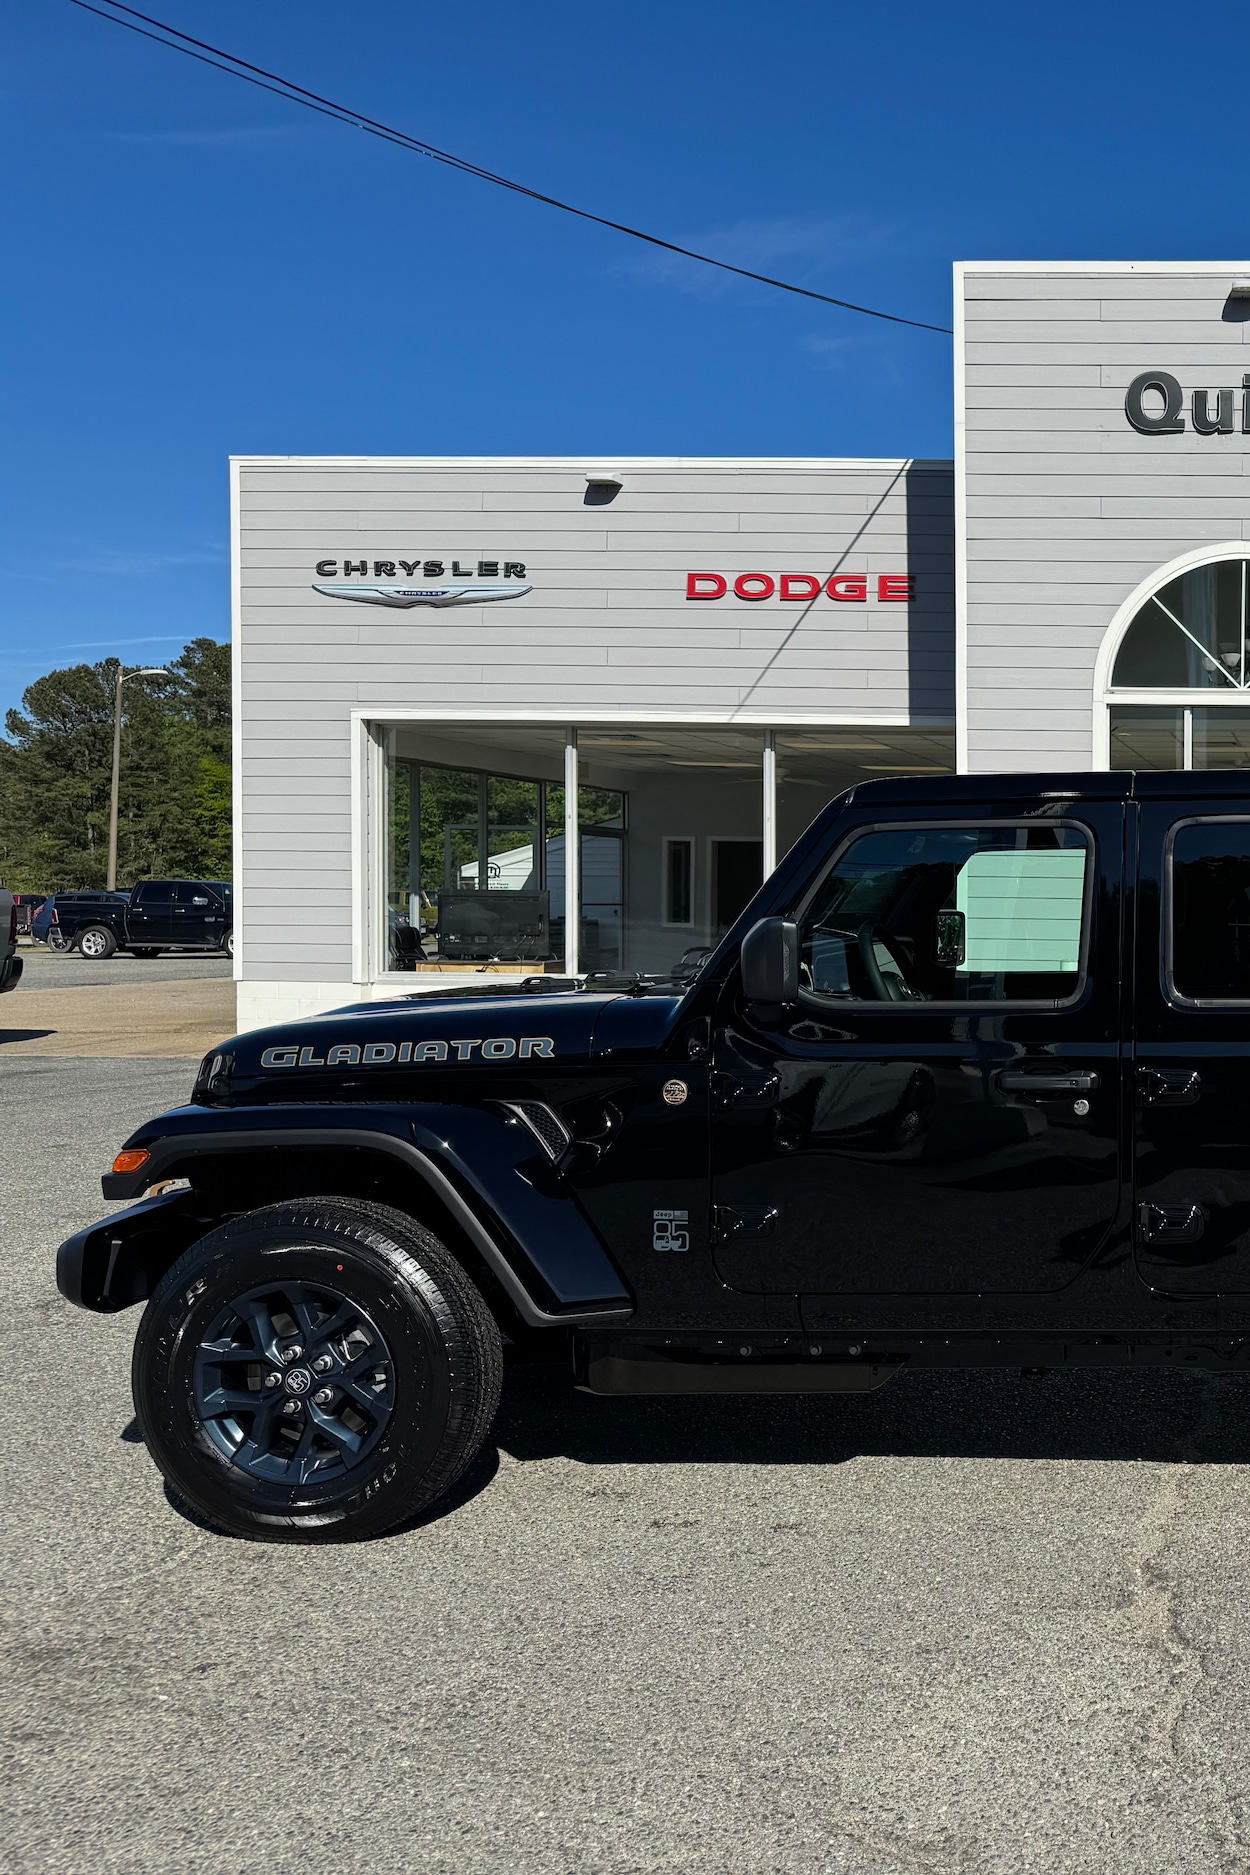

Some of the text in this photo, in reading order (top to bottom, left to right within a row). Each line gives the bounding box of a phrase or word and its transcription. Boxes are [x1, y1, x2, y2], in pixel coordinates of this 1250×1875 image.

[315, 559, 527, 579] CHRYSLER
[686, 572, 917, 603] DODGE
[260, 1037, 555, 1068] GLADIATOR
[653, 1220, 690, 1252] 85
